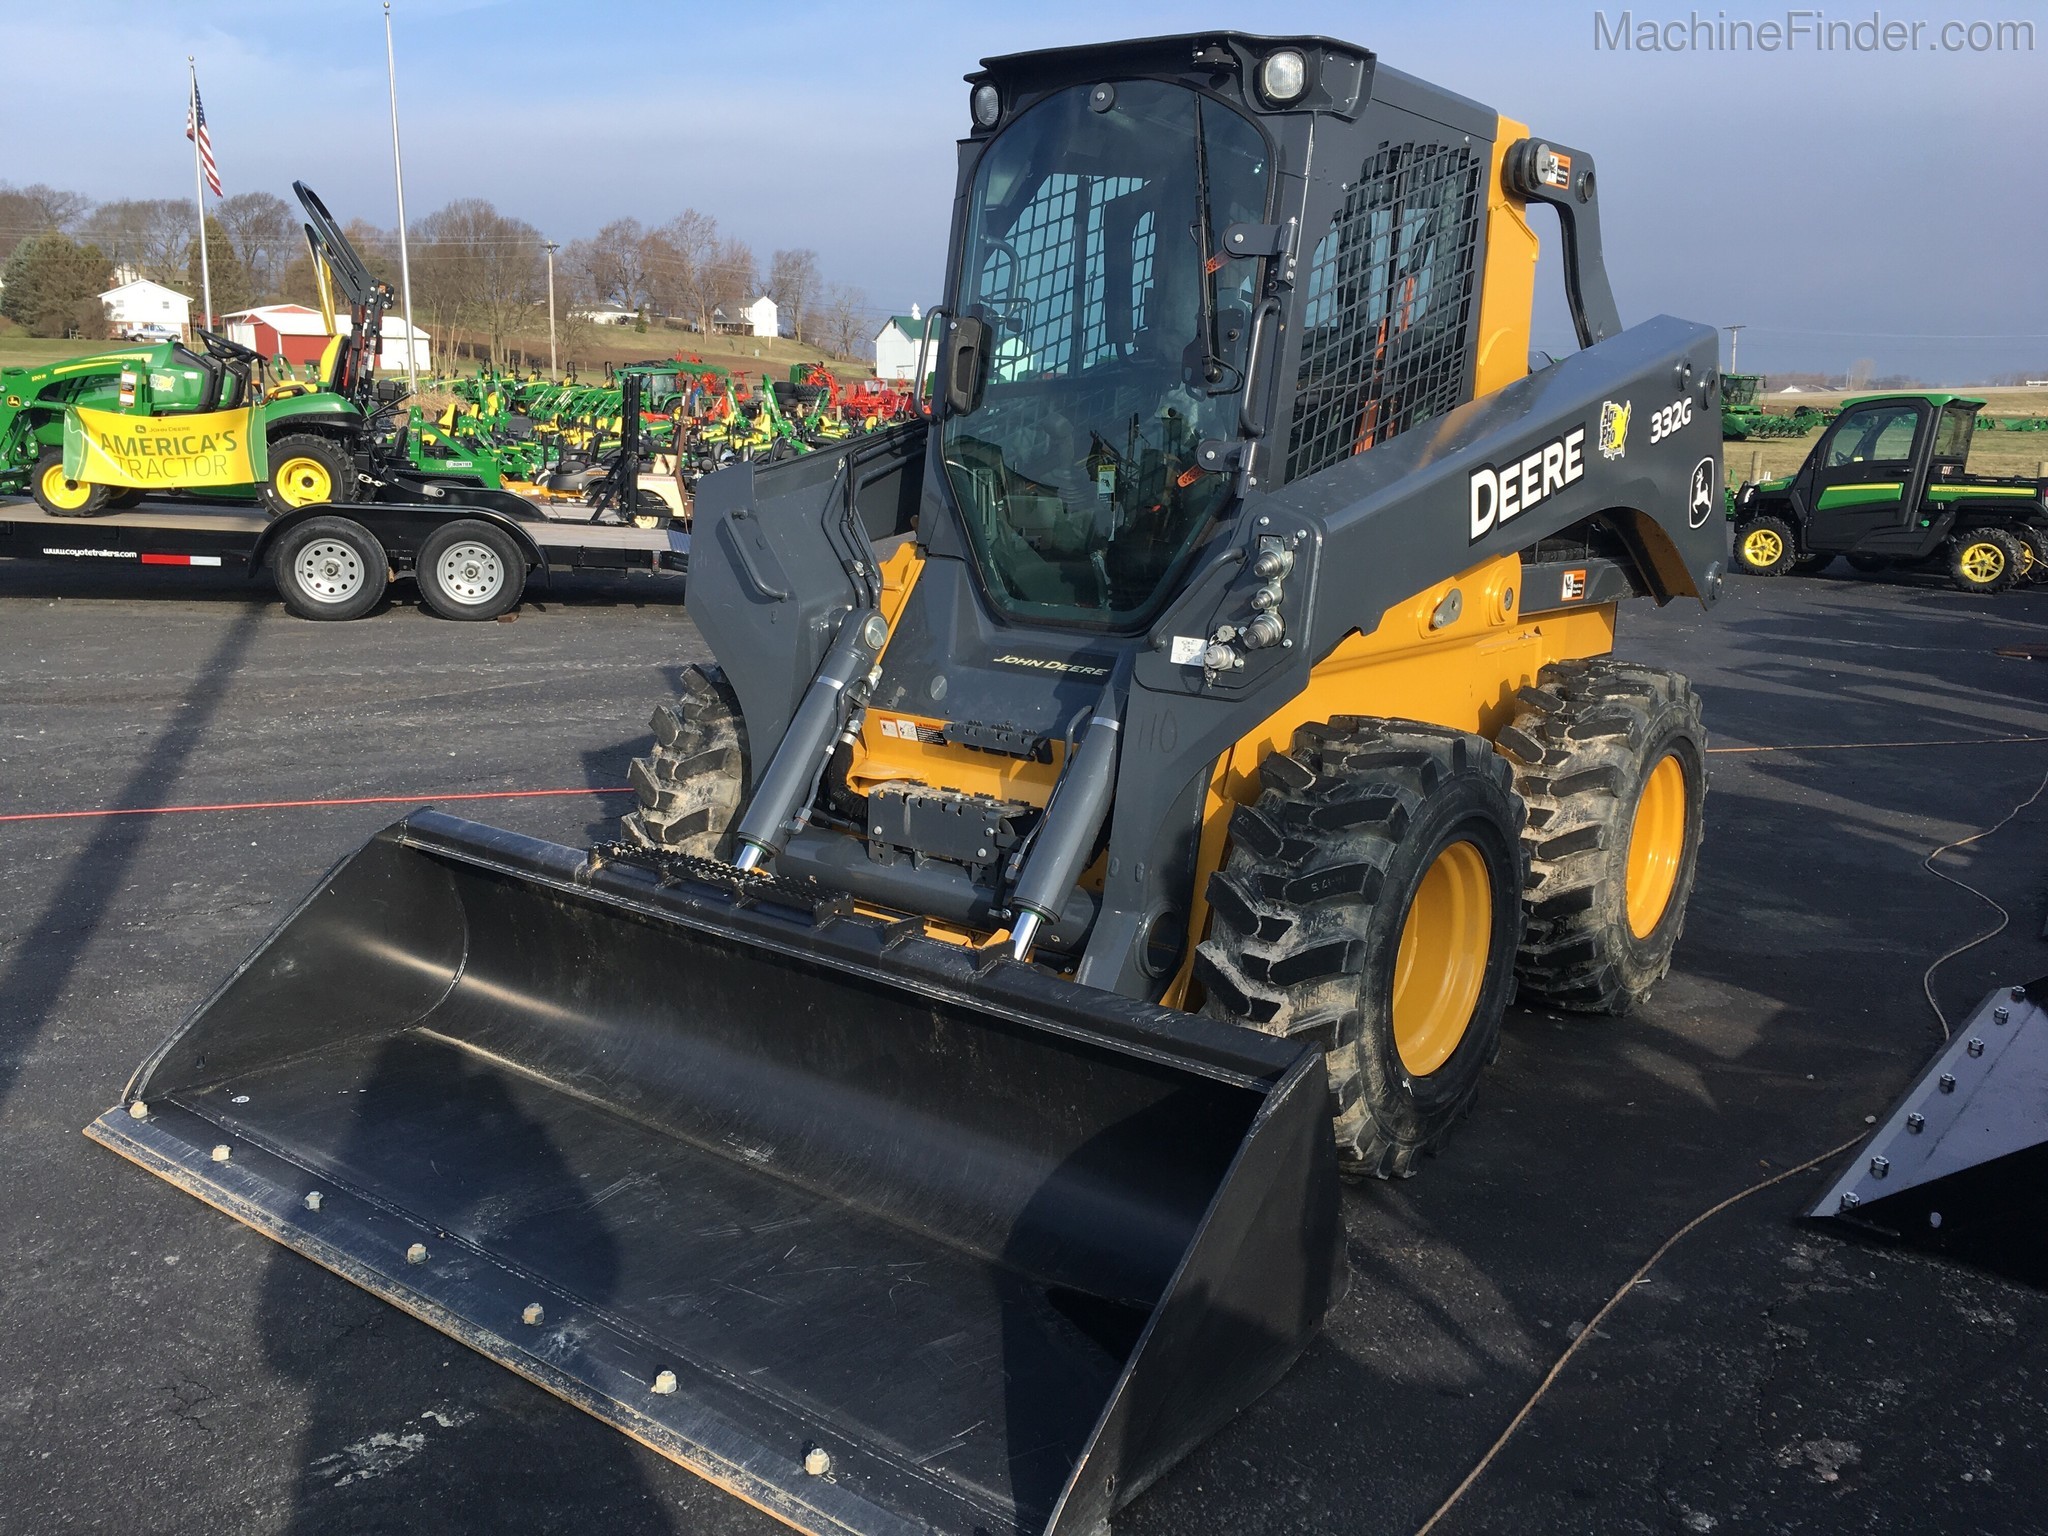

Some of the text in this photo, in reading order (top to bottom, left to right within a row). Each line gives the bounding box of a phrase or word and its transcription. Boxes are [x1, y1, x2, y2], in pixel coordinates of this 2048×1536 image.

[1650, 397, 1692, 445] 332G
[101, 430, 238, 457] AMERICA'S
[114, 454, 228, 480] TRACTOR
[1471, 429, 1584, 540] DEERE
[43, 548, 138, 559] www.coyotetrailers.com
[993, 655, 1109, 676] JOHN DEERE
